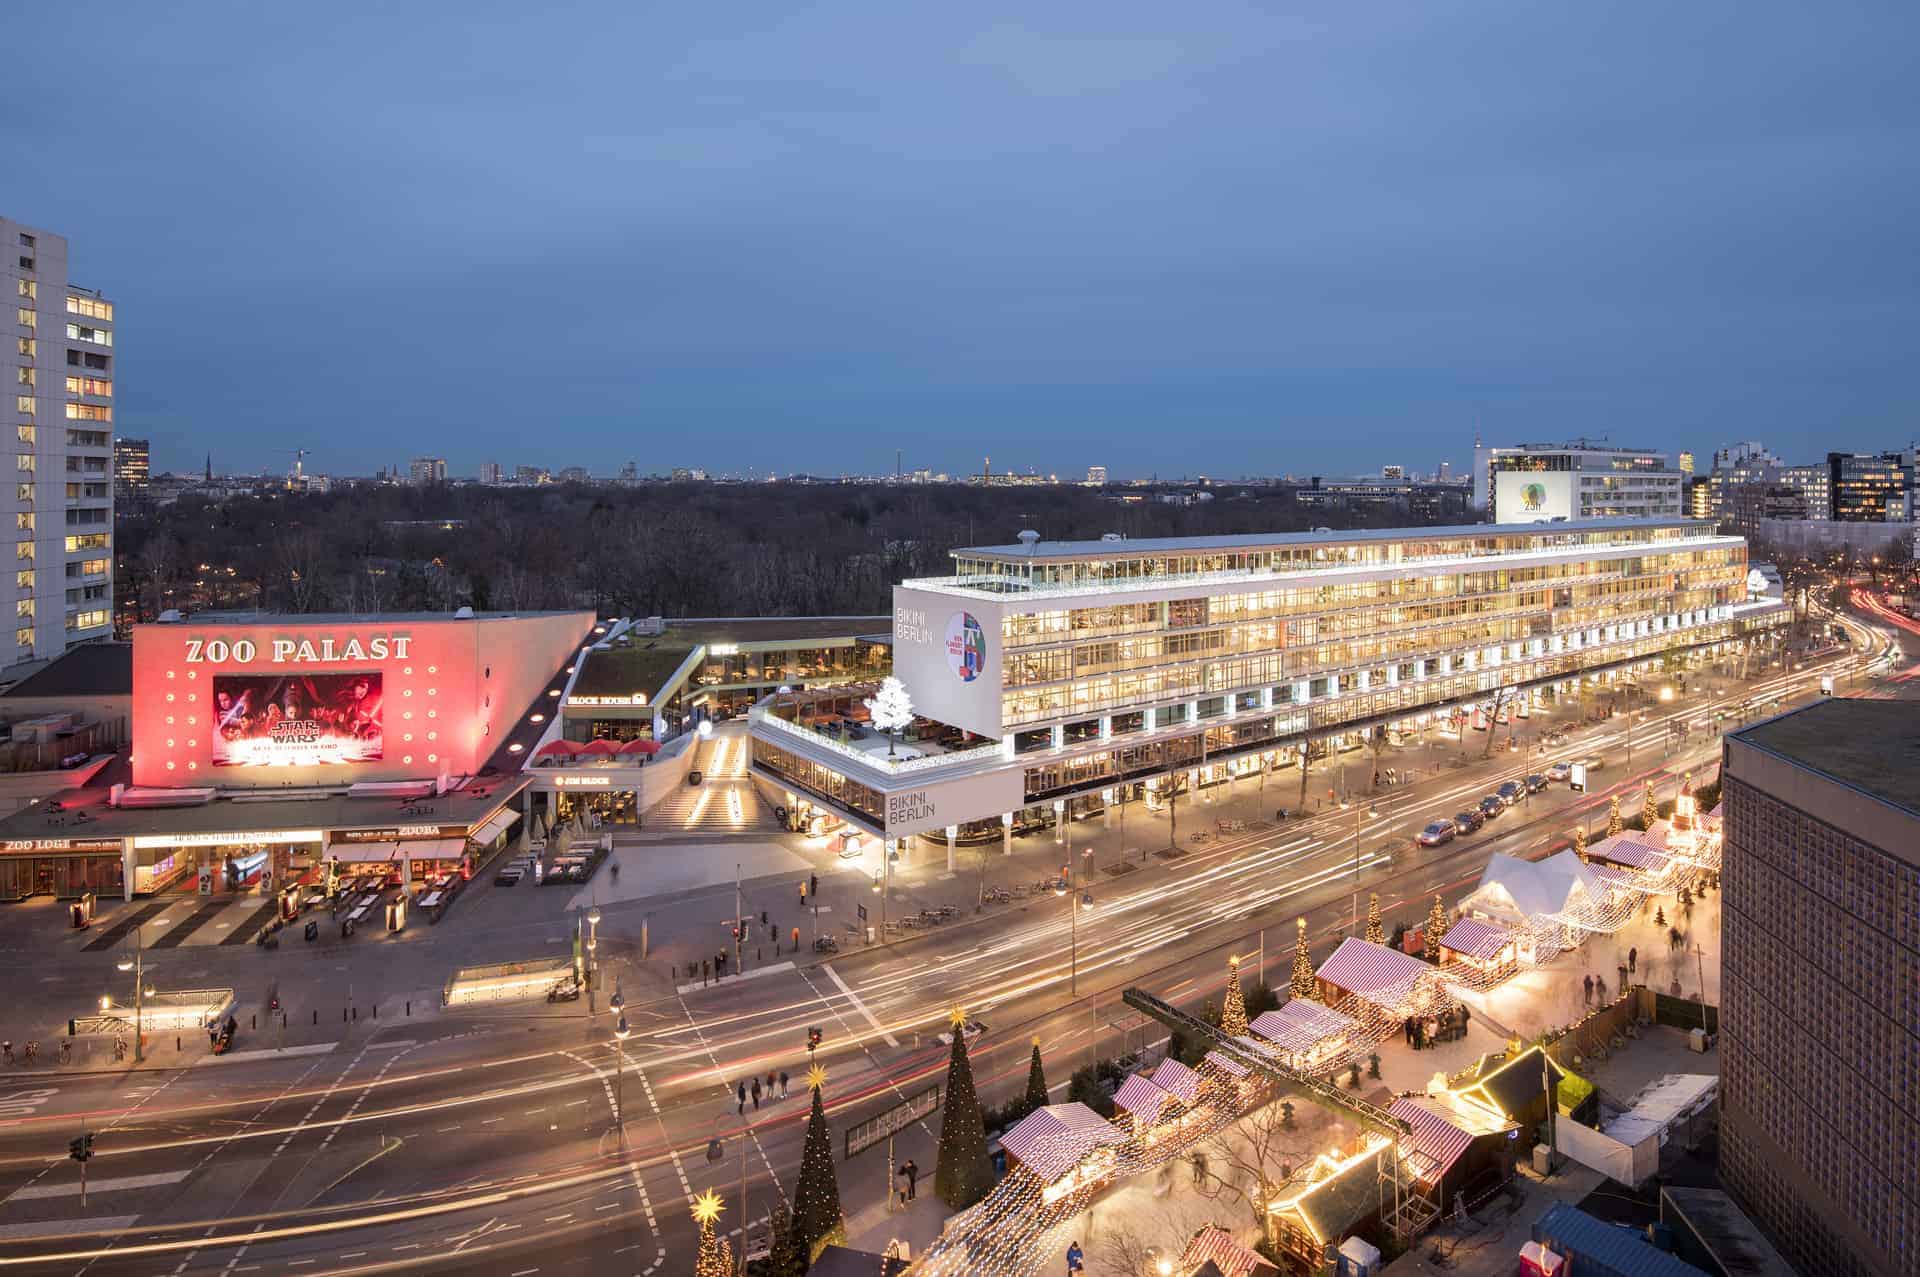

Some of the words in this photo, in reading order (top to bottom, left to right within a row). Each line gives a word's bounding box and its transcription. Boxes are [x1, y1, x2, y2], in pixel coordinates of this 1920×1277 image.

[896, 607, 926, 625] BIKINI
[896, 624, 935, 646] BERLIN
[185, 640, 256, 663] ZOO
[272, 637, 411, 662] PALAST
[271, 720, 320, 731] STAR
[272, 734, 319, 744] WARS
[889, 791, 926, 811] BIKINI
[889, 803, 936, 825] BERLIN
[6, 839, 33, 849] ZOO
